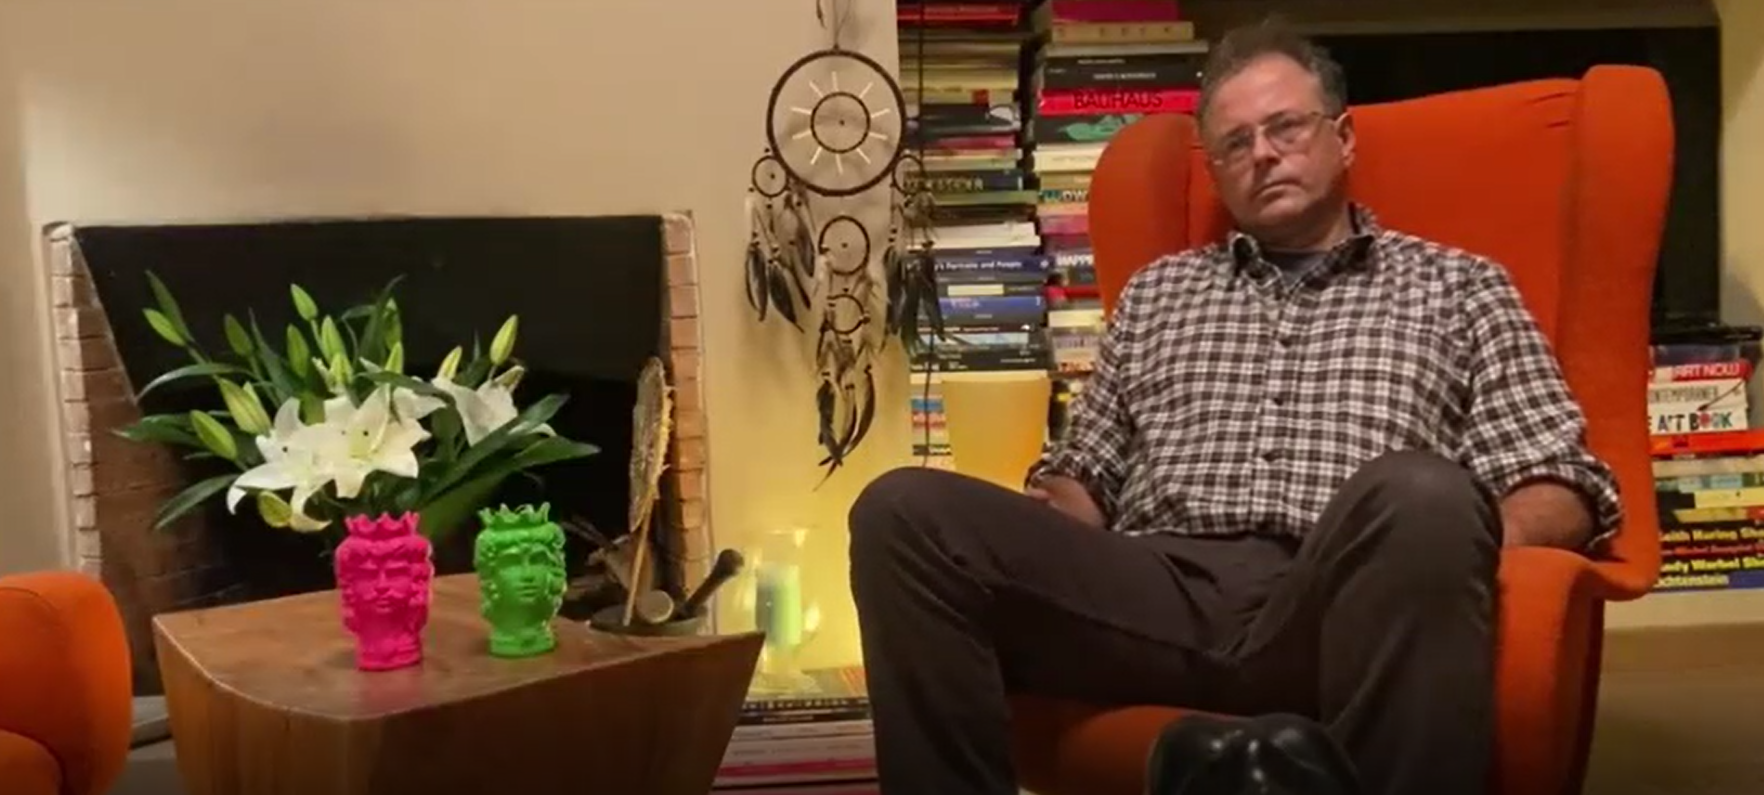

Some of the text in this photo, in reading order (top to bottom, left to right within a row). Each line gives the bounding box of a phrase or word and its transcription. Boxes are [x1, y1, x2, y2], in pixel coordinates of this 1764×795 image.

[1073, 92, 1163, 109] BAUHAUS
[980, 260, 995, 269] and
[1673, 363, 1740, 378] ART NOW
[1690, 557, 1740, 571] Warhol
